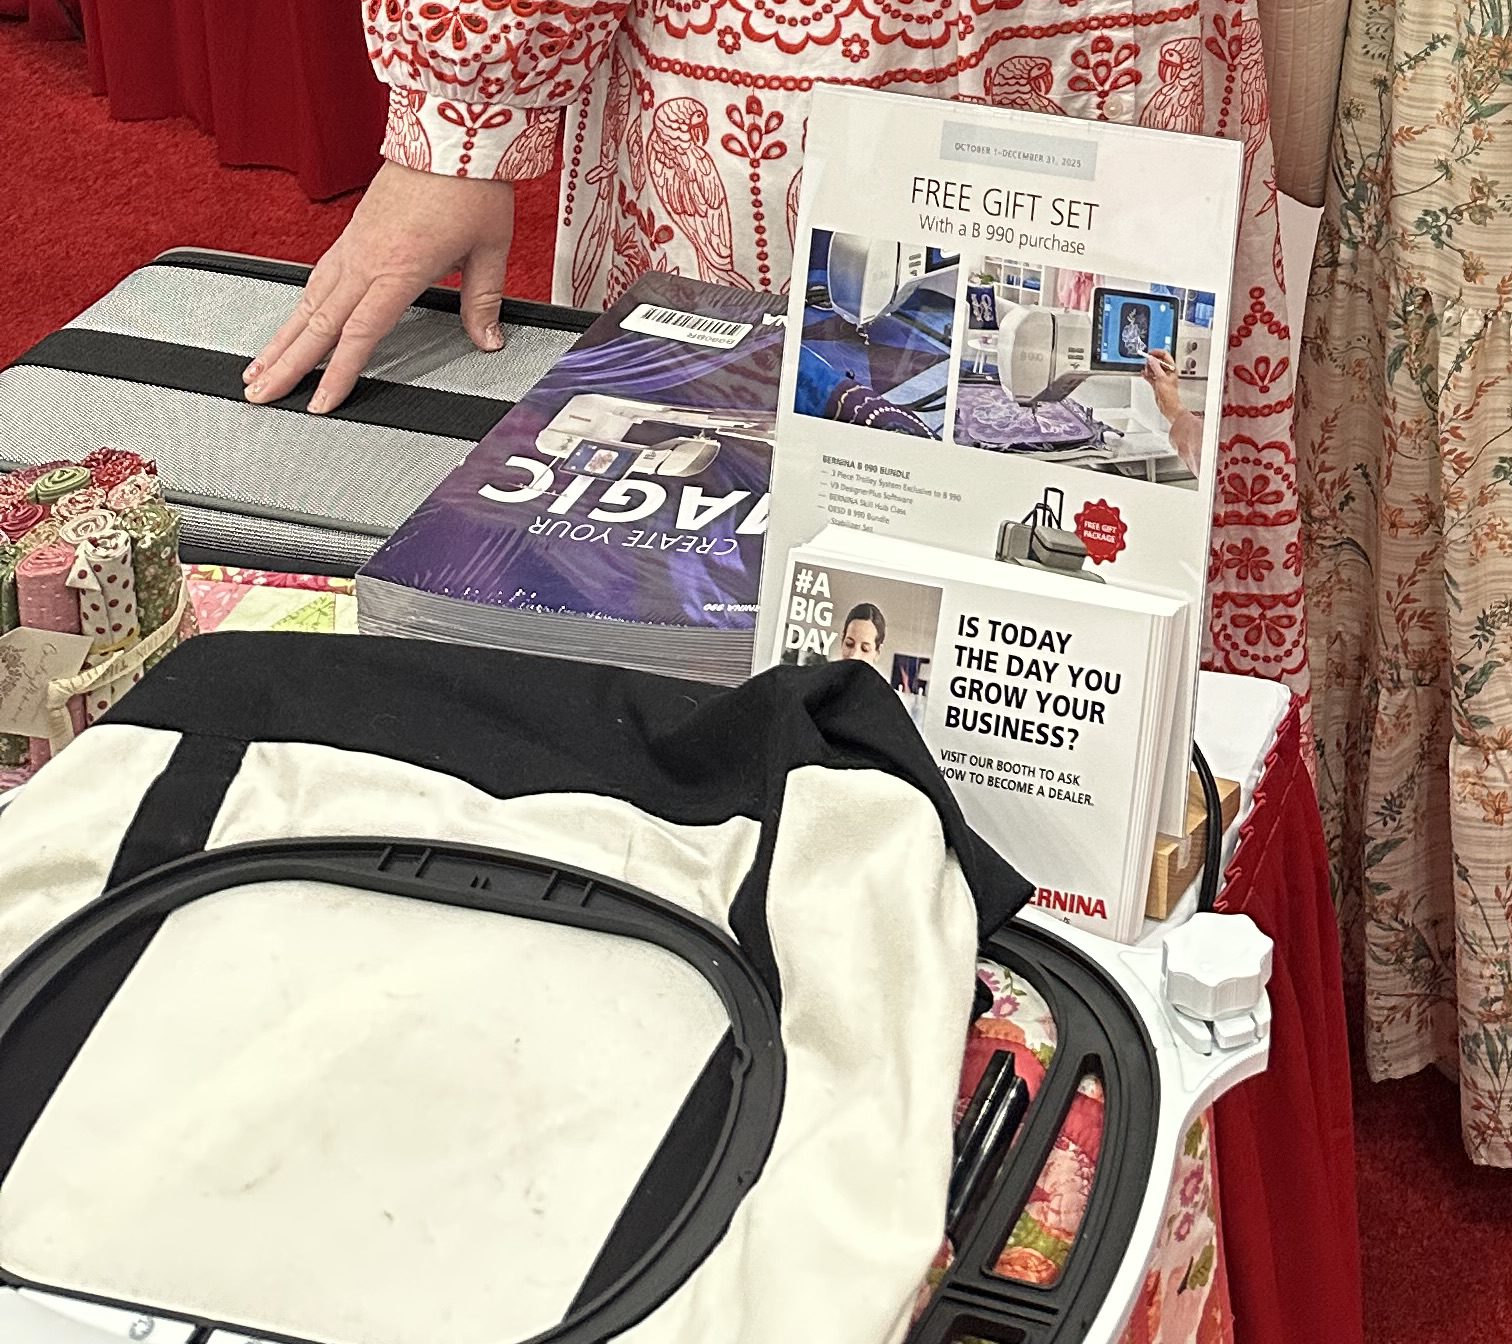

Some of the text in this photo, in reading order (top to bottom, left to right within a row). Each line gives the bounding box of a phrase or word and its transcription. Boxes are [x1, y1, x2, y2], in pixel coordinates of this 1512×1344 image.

[954, 141, 991, 155] OCTOBER
[1061, 157, 1082, 169] 2025
[911, 176, 1100, 231] FREE GIFT SET
[918, 213, 1086, 256] With a B 990 purchase
[822, 454, 855, 470] BERNINA
[879, 465, 911, 480] BUNDLE
[527, 515, 739, 557] CREATE YOUR
[794, 567, 831, 599] #A
[789, 596, 833, 627] BIG
[785, 625, 839, 657] DAY
[957, 614, 1073, 655] IS TODAY
[953, 644, 1122, 695] THE DAY YOU
[949, 675, 1106, 725] GROW YOUR
[944, 705, 1080, 751] BUSINESS?
[940, 748, 1082, 787] VISIT OUR BOOTH TO ASK
[969, 771, 985, 785] TO
[987, 775, 1035, 796] BECOME
[1036, 785, 1046, 798] A
[1048, 787, 1095, 807] DEALER.
[1027, 886, 1108, 920] RNINA
